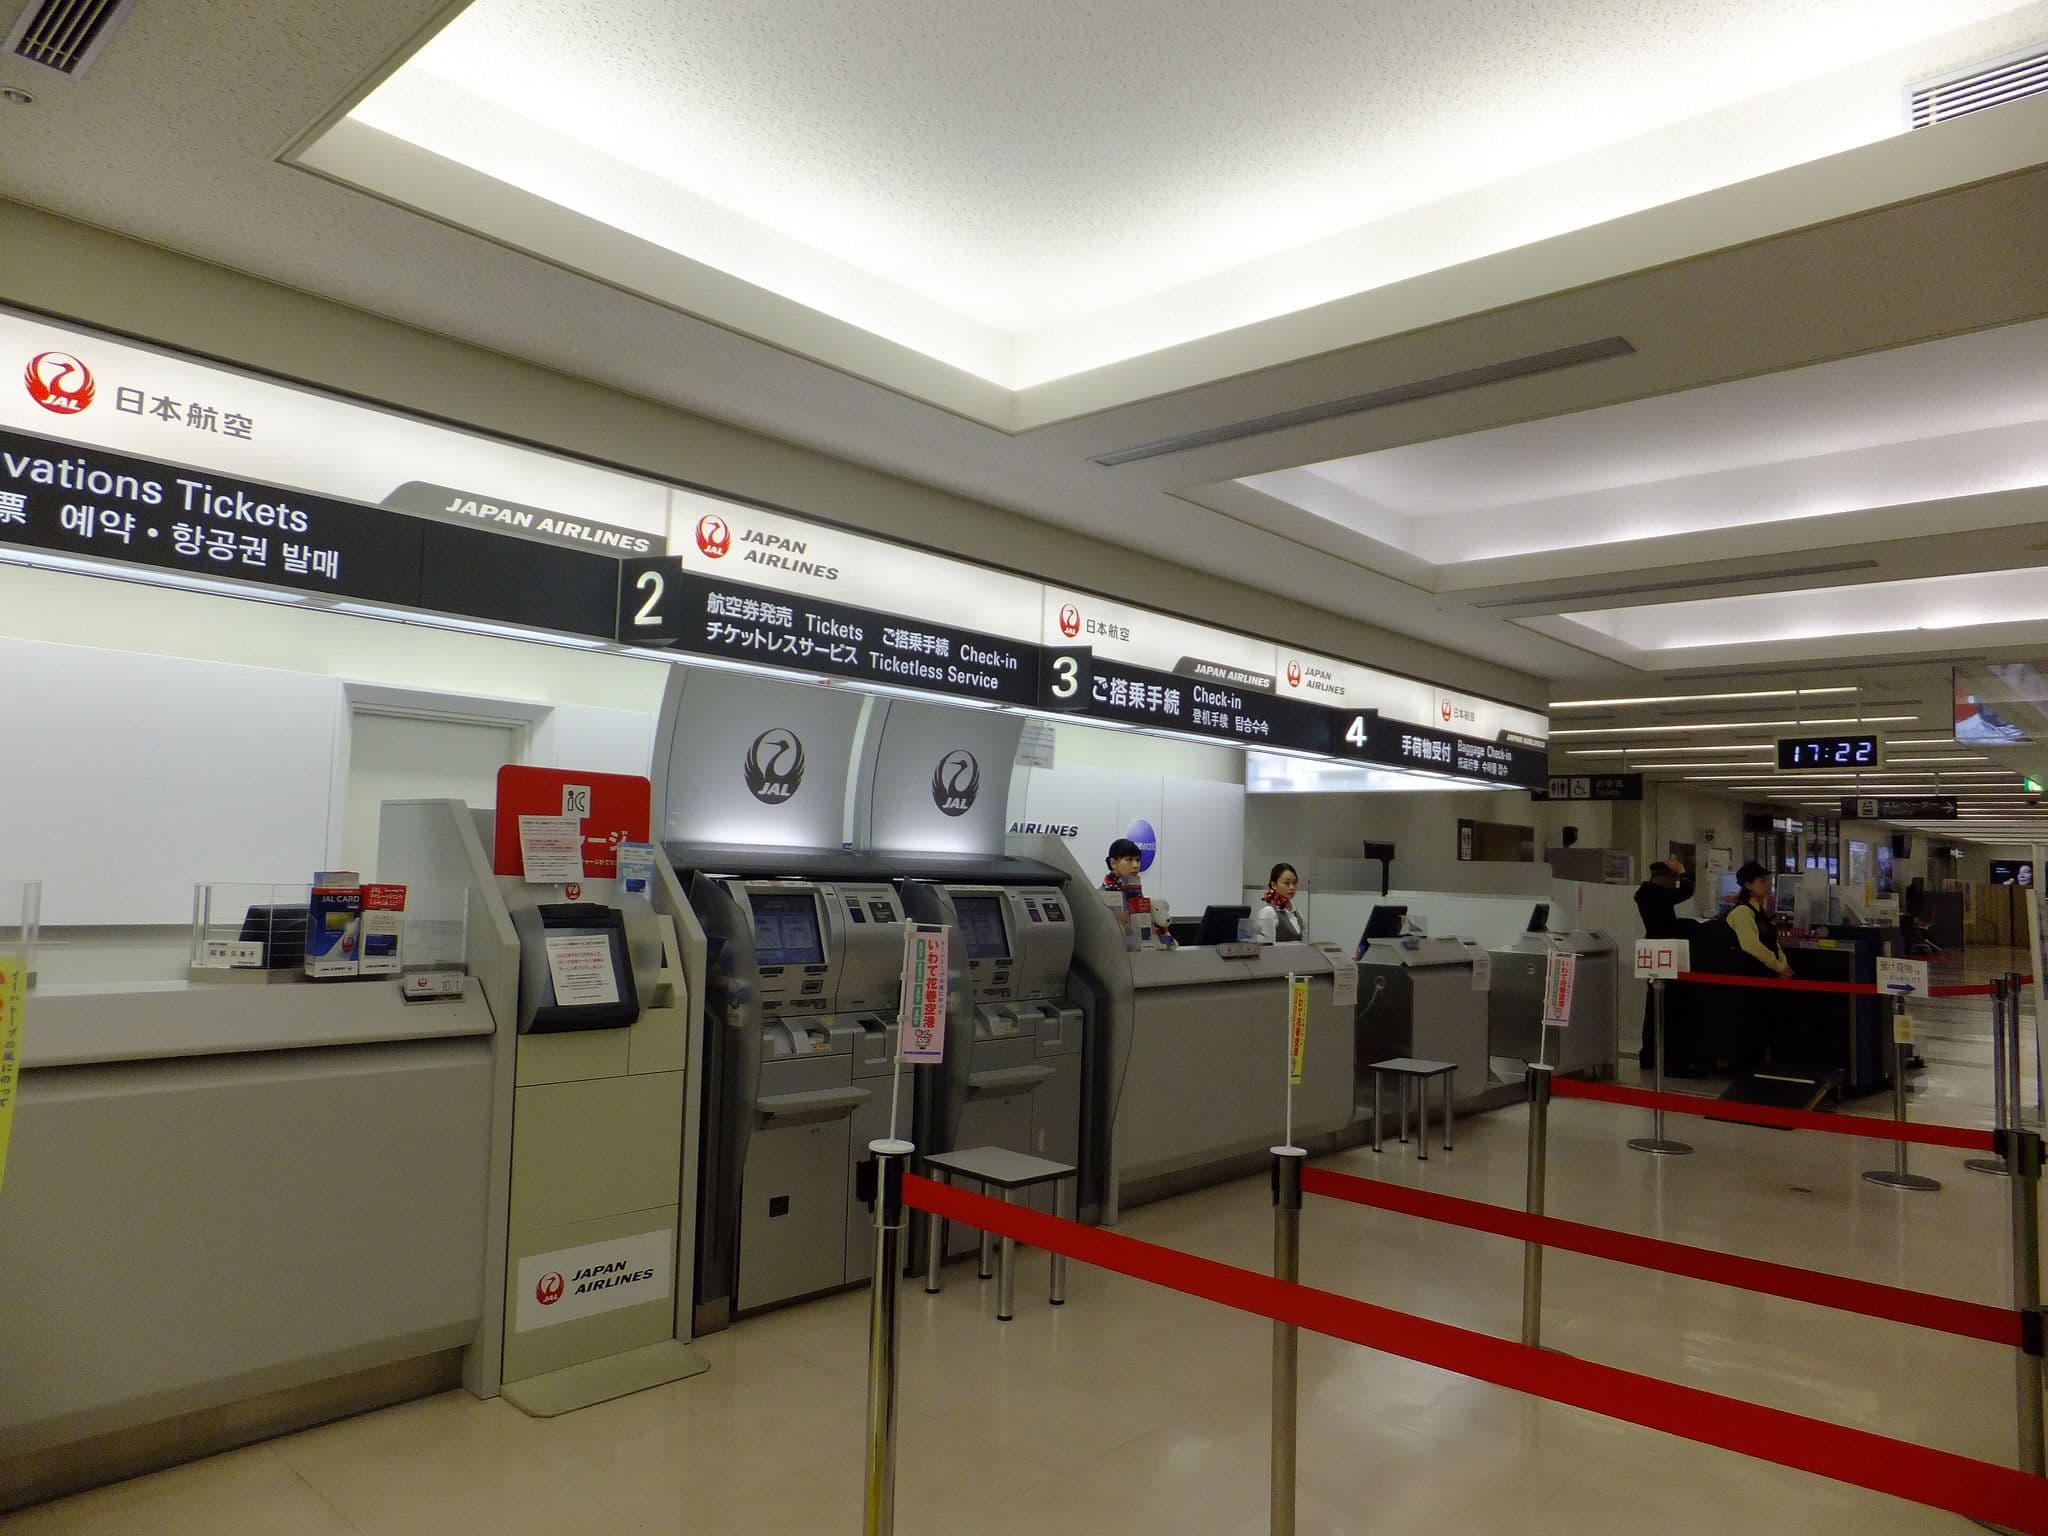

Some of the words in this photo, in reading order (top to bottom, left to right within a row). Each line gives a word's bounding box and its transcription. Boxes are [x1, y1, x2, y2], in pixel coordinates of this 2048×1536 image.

[41, 394, 82, 411] JAL
[116, 386, 252, 440] 日本航空
[176, 478, 309, 532] Tickets
[445, 498, 533, 528] JAPAN
[536, 518, 650, 552] AIRLINES
[703, 546, 724, 555] JAL
[741, 529, 807, 555] JAPAN
[281, 541, 340, 579] 발매
[743, 549, 839, 580] AIRLINES
[634, 570, 665, 625] 2
[707, 591, 793, 628] 航空券発売
[805, 613, 864, 641] Tickets
[882, 627, 949, 658] ご搭乗手続
[960, 644, 1017, 670] Check-in
[1086, 619, 1130, 642] 日本航空
[706, 621, 858, 665] チケットレスサービス
[869, 651, 943, 680] Ticketless
[947, 665, 999, 690] Service
[1051, 656, 1079, 698] 3
[1194, 664, 1227, 679] JAPAN
[1227, 672, 1270, 688] AIRLINES
[1304, 667, 1332, 680] JAPAN
[1092, 675, 1181, 716] ご搭乗手続
[1193, 685, 1242, 710] Check-in
[1306, 680, 1345, 696] AIRLINES
[1345, 716, 1368, 747] 4
[1401, 735, 1451, 763] 手荷物受付
[1794, 742, 1871, 762] 17:22
[757, 782, 791, 797] JAL
[942, 797, 969, 810] JAL
[1009, 822, 1079, 837] AIRLINES
[336, 895, 360, 903] CARD
[1637, 948, 1672, 969] 出口
[923, 940, 939, 1029] いわて花巻空港
[571, 1260, 627, 1281] JAPAN
[574, 1269, 654, 1295] AIRLINES
